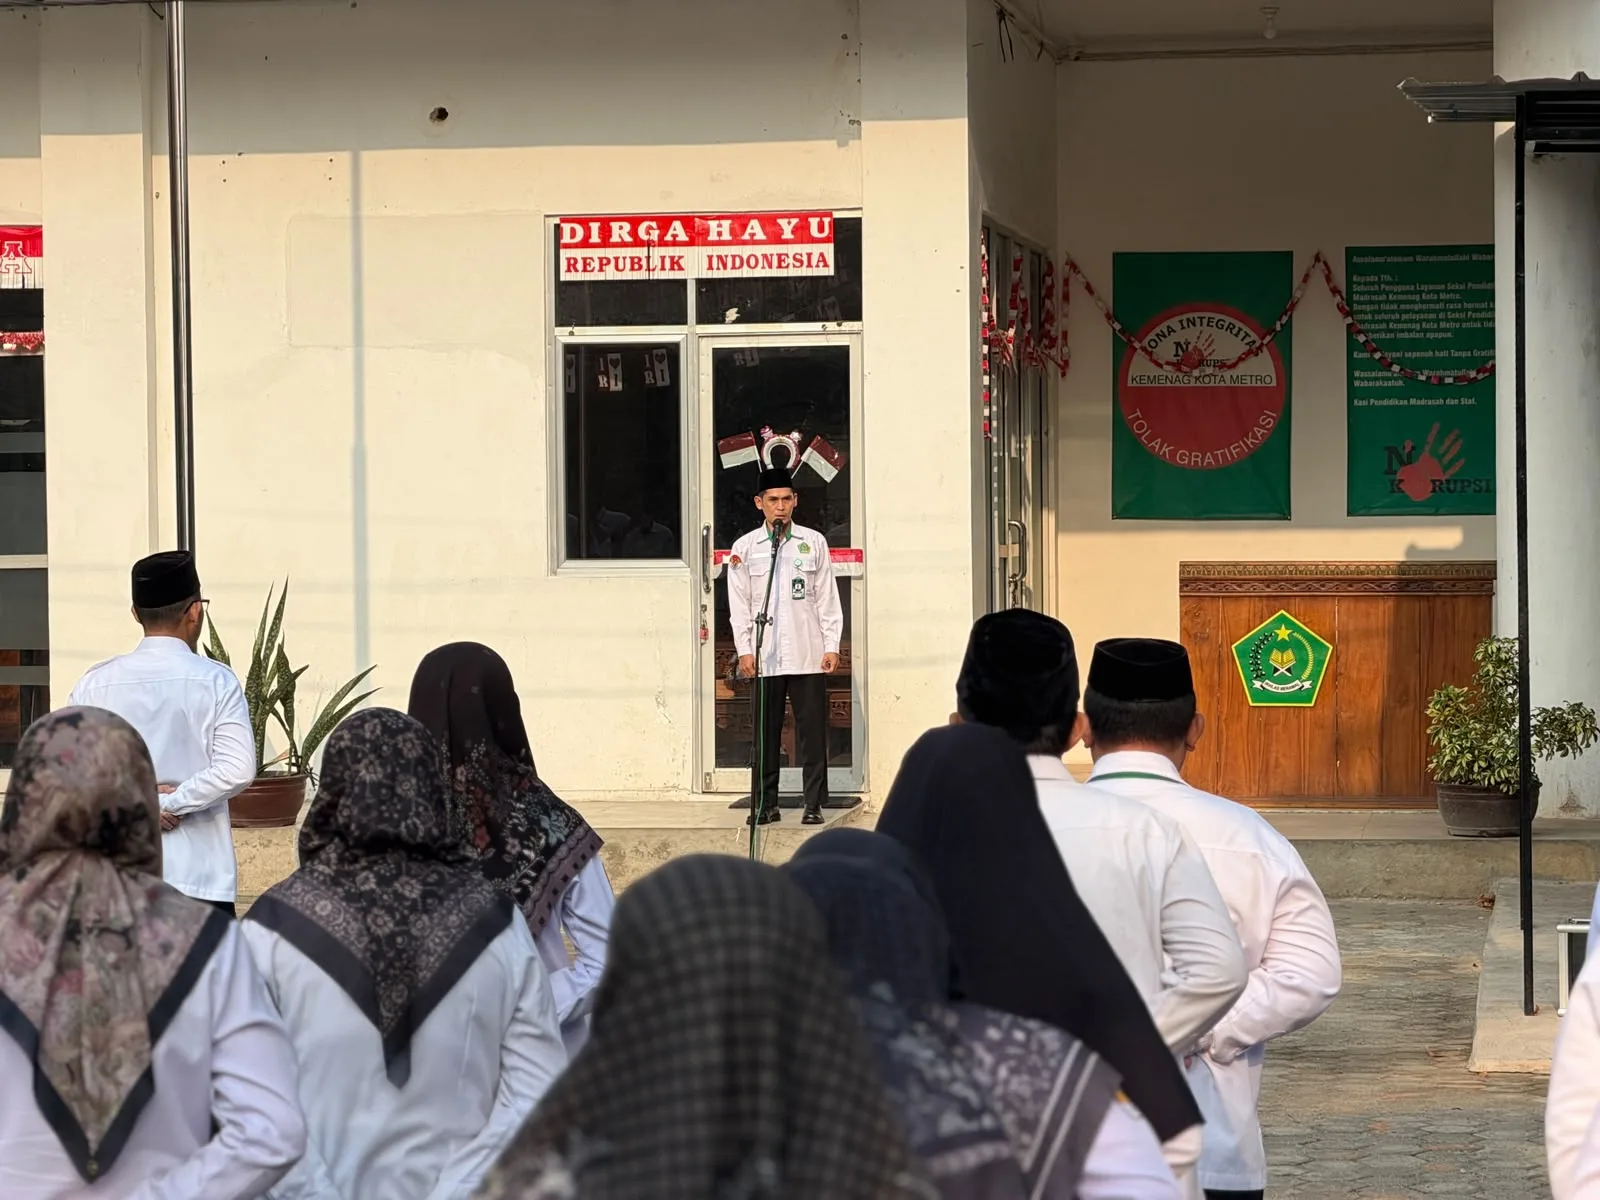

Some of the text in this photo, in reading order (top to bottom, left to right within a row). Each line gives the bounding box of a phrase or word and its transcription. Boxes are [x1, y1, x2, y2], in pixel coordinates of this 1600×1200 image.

[564, 251, 830, 273] REPUBLIK INDONESIA
[1353, 293, 1387, 301] Madrasah
[1388, 293, 1420, 302] Kemenag
[1380, 302, 1398, 310] tidak
[1388, 321, 1420, 331] Kemenag
[1422, 321, 1438, 329] Kota
[1439, 321, 1461, 329] Metro
[1146, 323, 1176, 351] ONA
[1450, 349, 1471, 359] Tanpa
[1131, 373, 1273, 386] KEMENAG KOTA METRO
[1353, 398, 1369, 407] Kasi
[1369, 397, 1408, 406] Pendidikan
[1409, 397, 1444, 406] Madrasah
[1445, 397, 1458, 405] dan
[1127, 408, 1277, 467] TOLAK GRATIFIKASI
